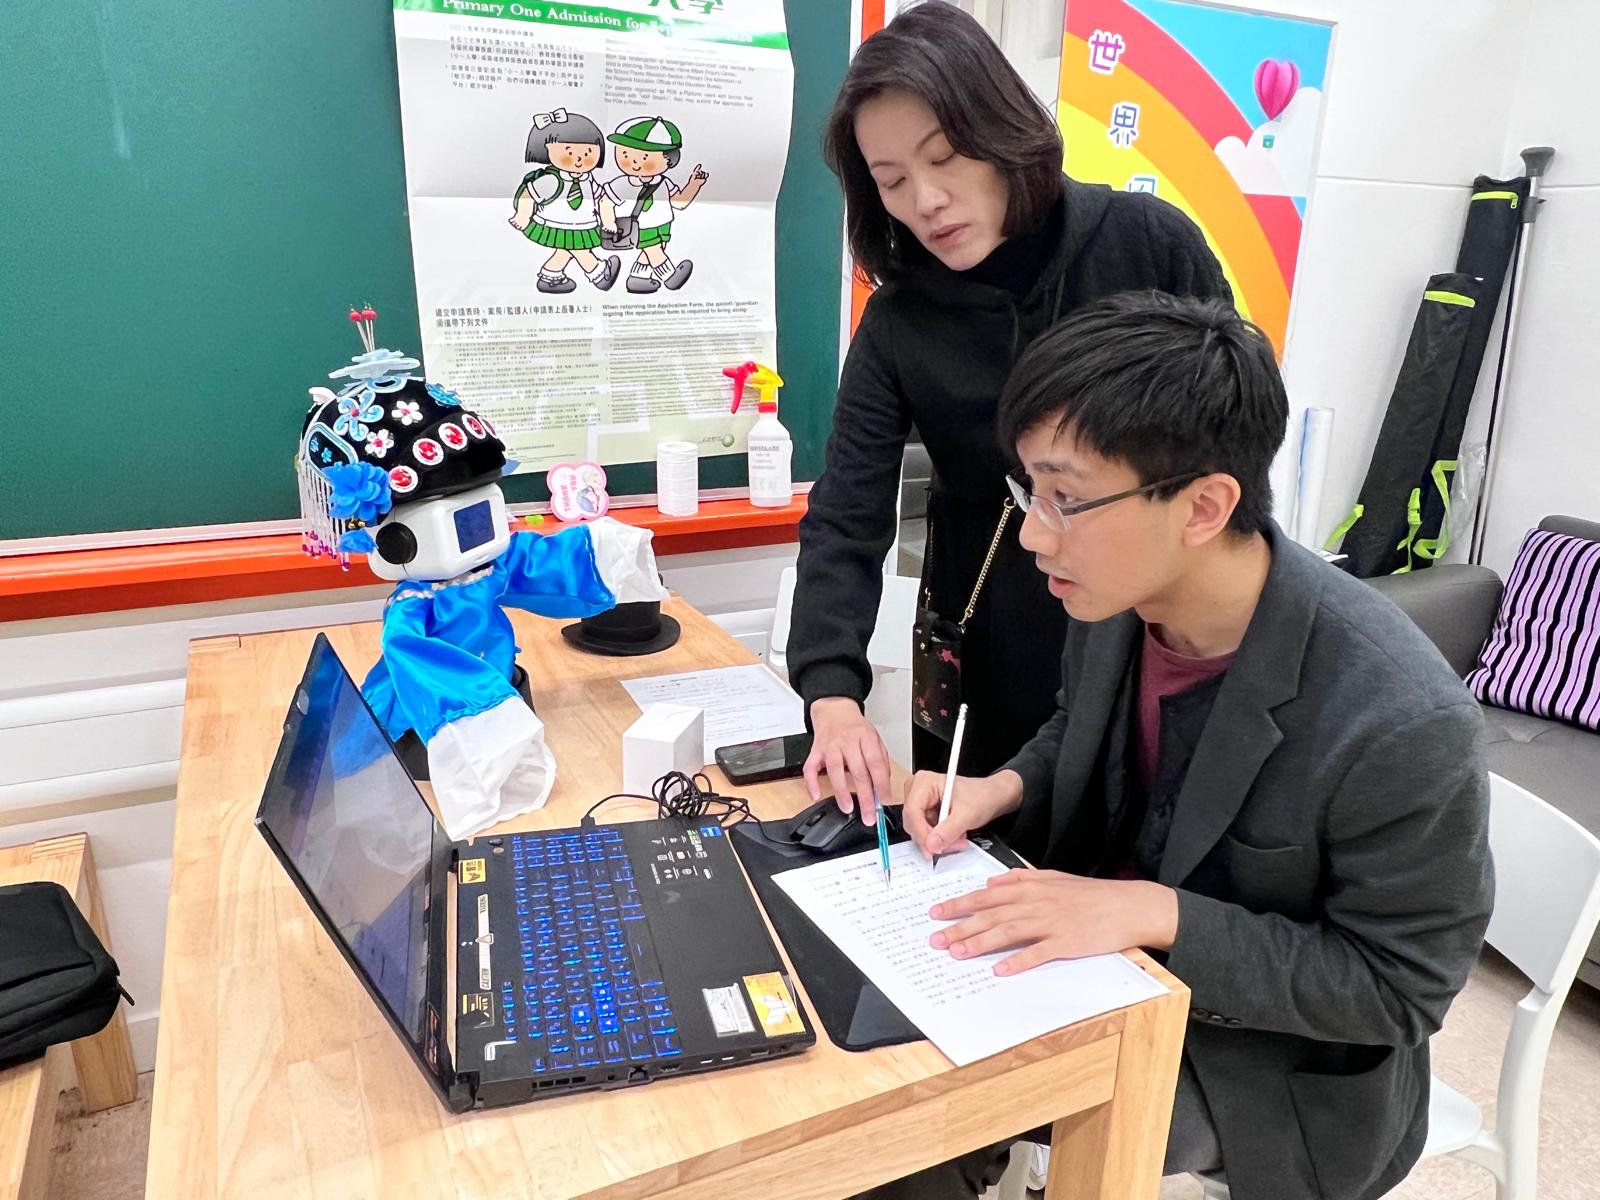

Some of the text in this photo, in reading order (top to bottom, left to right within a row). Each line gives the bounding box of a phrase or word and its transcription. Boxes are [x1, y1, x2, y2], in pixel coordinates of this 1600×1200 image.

[442, 0, 504, 15] Primary
[510, 3, 542, 17] One
[547, 7, 622, 26] Admission
